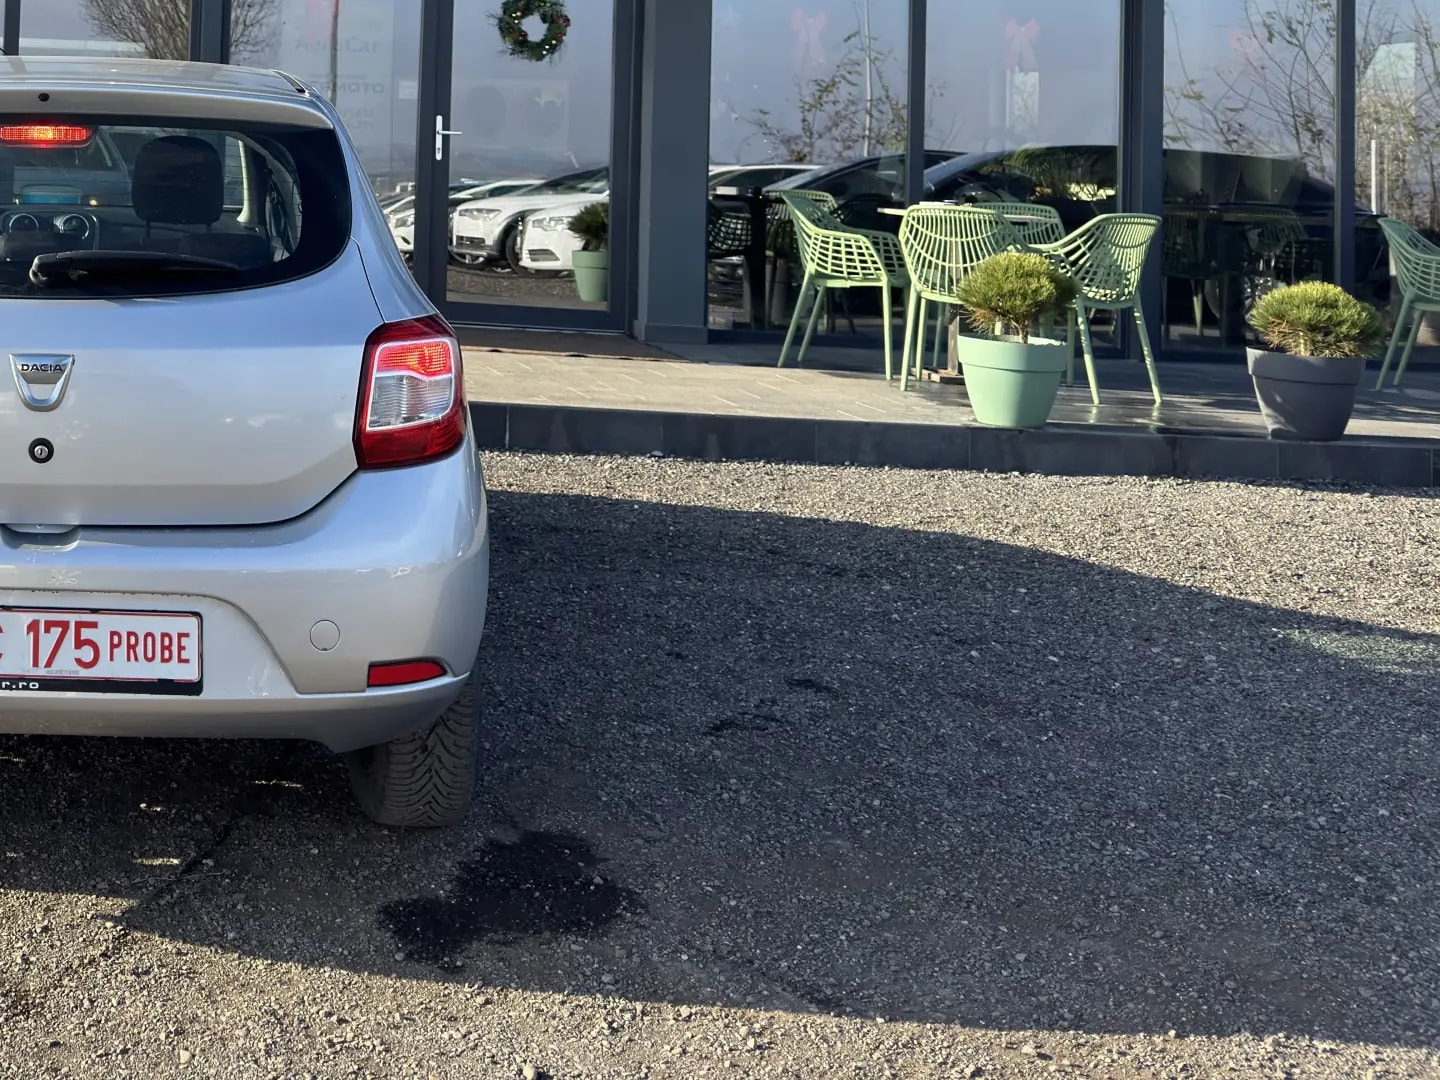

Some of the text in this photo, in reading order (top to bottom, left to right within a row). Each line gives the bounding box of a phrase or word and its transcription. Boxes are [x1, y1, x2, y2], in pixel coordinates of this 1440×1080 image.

[20, 362, 64, 374] DACIA
[26, 619, 100, 670] 175
[108, 630, 191, 664] PROBE
